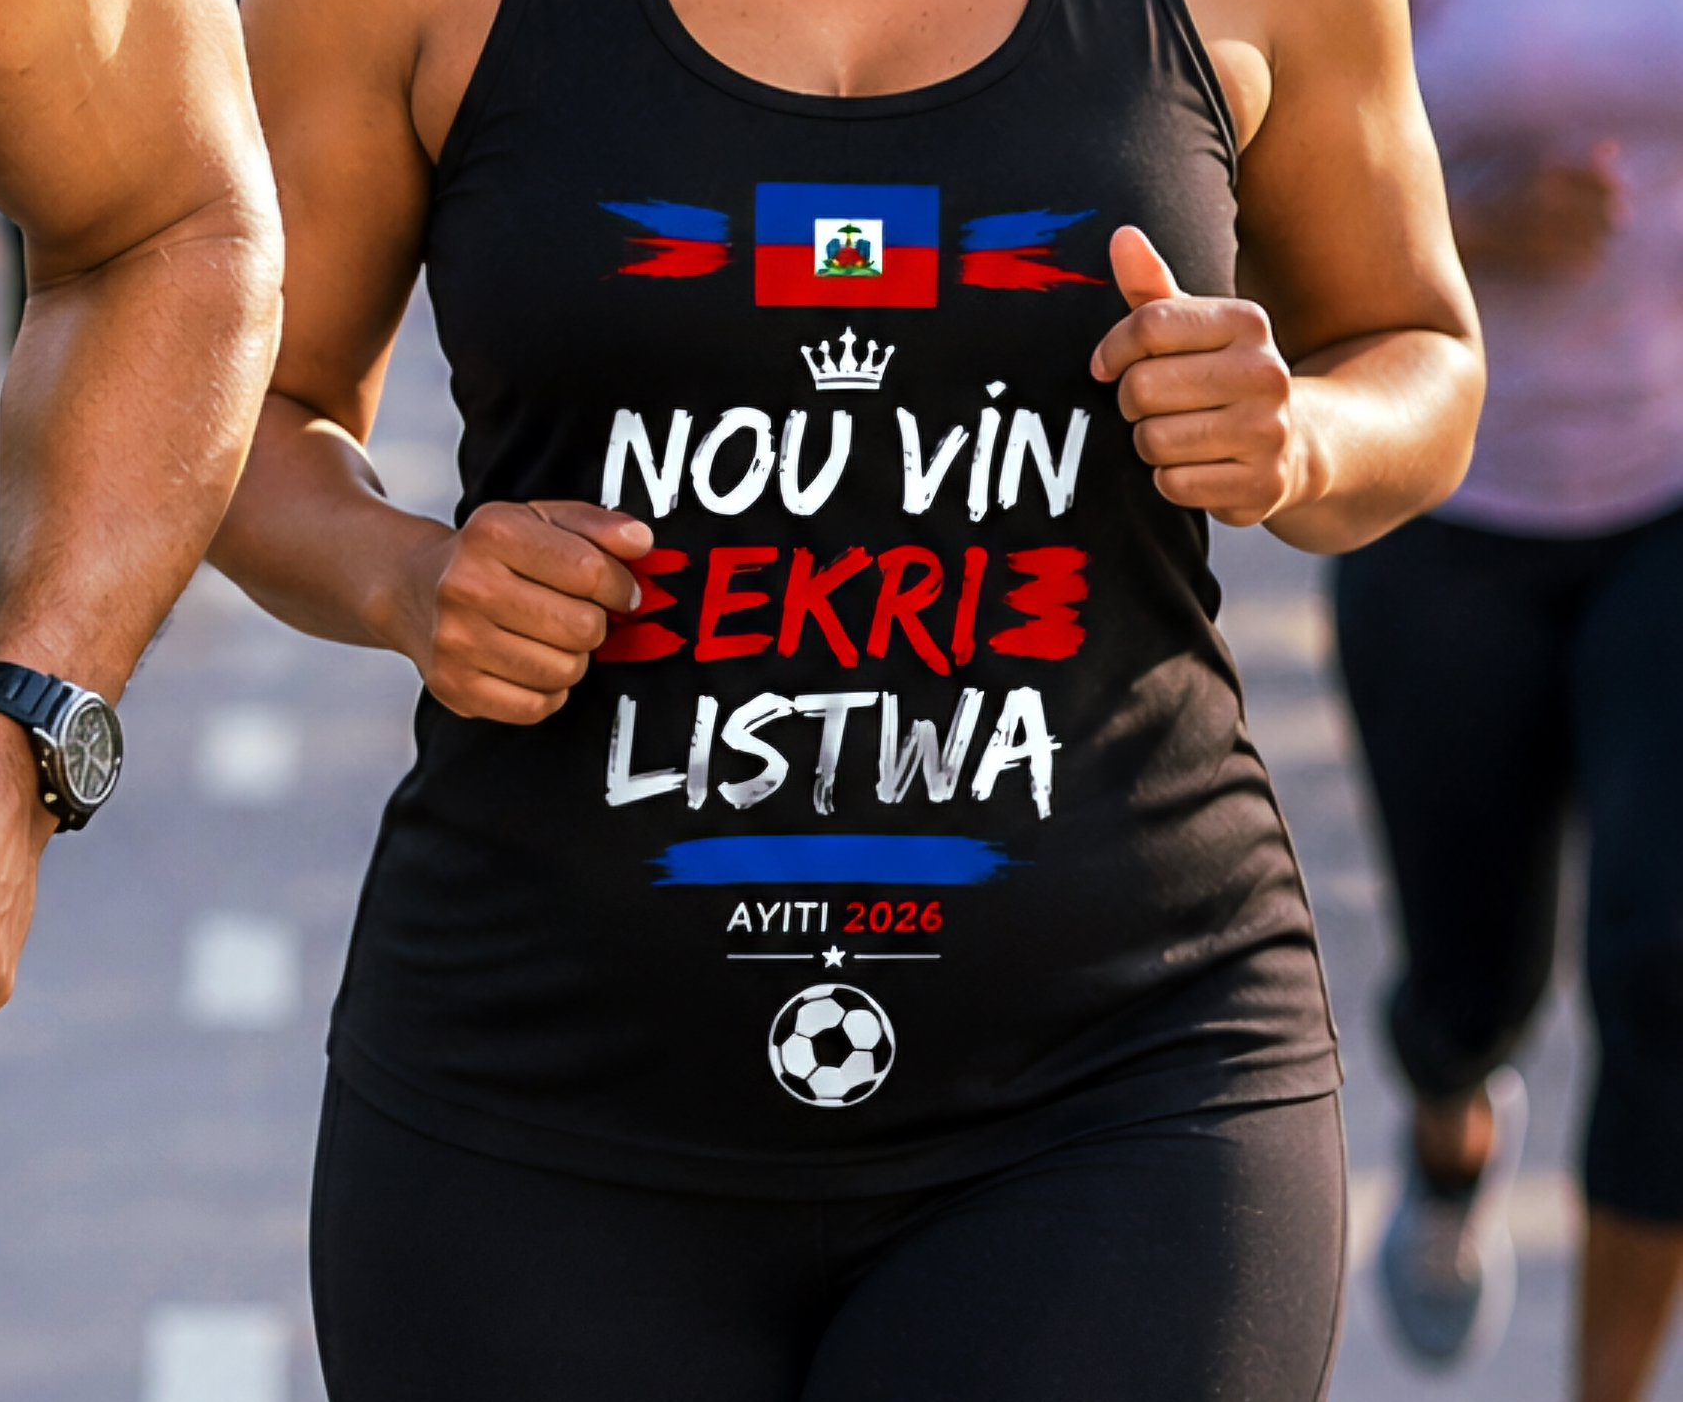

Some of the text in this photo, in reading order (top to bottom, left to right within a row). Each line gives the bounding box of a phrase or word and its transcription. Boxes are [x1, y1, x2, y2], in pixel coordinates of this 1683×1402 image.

[601, 407, 853, 518] NOU
[694, 545, 988, 676] EKRI
[605, 687, 1063, 820] LISTWA
[726, 901, 945, 934] AYITI 2026
